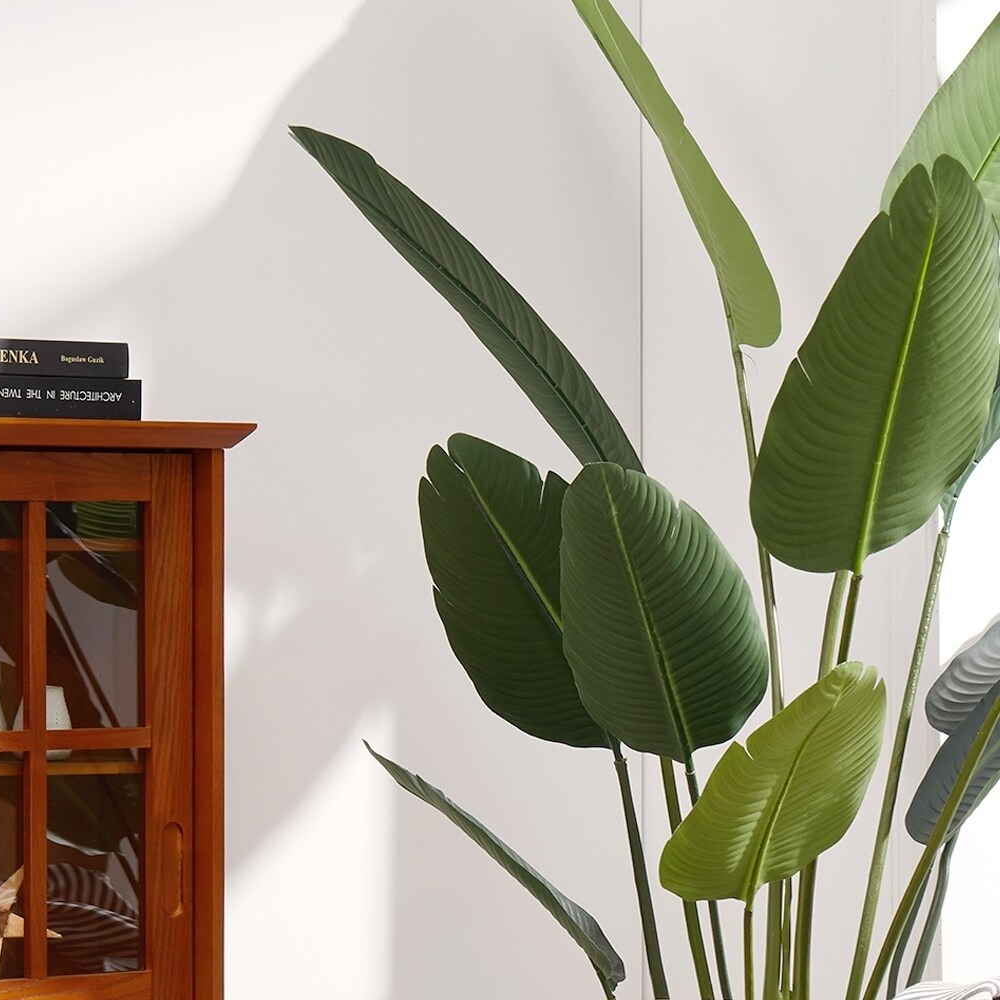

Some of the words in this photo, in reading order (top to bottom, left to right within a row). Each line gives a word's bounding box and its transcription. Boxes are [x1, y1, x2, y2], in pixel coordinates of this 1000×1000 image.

[26, 388, 42, 399] THE
[46, 389, 56, 400] IN
[60, 389, 122, 402] ARCHITECTURE
